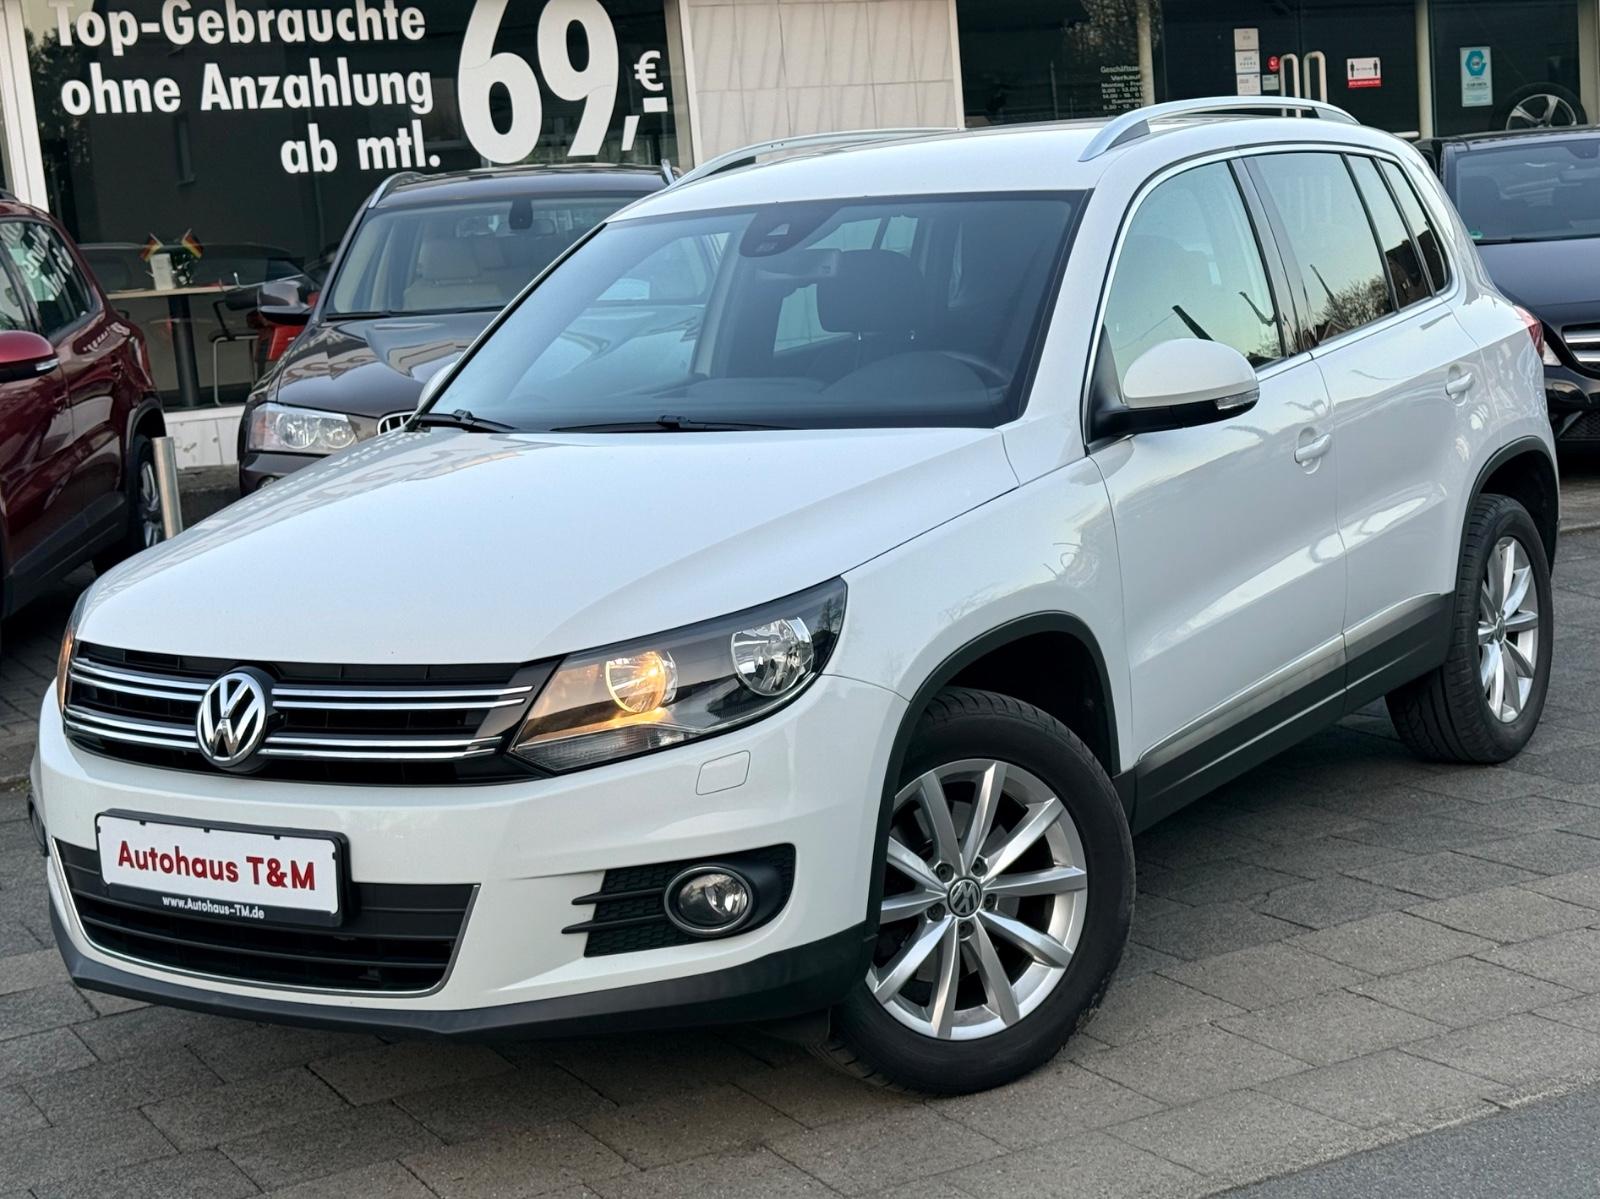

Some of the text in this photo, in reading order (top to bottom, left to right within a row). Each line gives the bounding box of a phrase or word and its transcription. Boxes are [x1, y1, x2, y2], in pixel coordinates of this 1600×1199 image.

[49, 0, 426, 56] Top-Gebrauchte
[61, 57, 434, 116] ohne Anzahlung
[280, 119, 441, 173] ab mtl.
[117, 840, 316, 891] Autohaus T&M
[162, 895, 265, 919] www.Autohaus-TM.de
